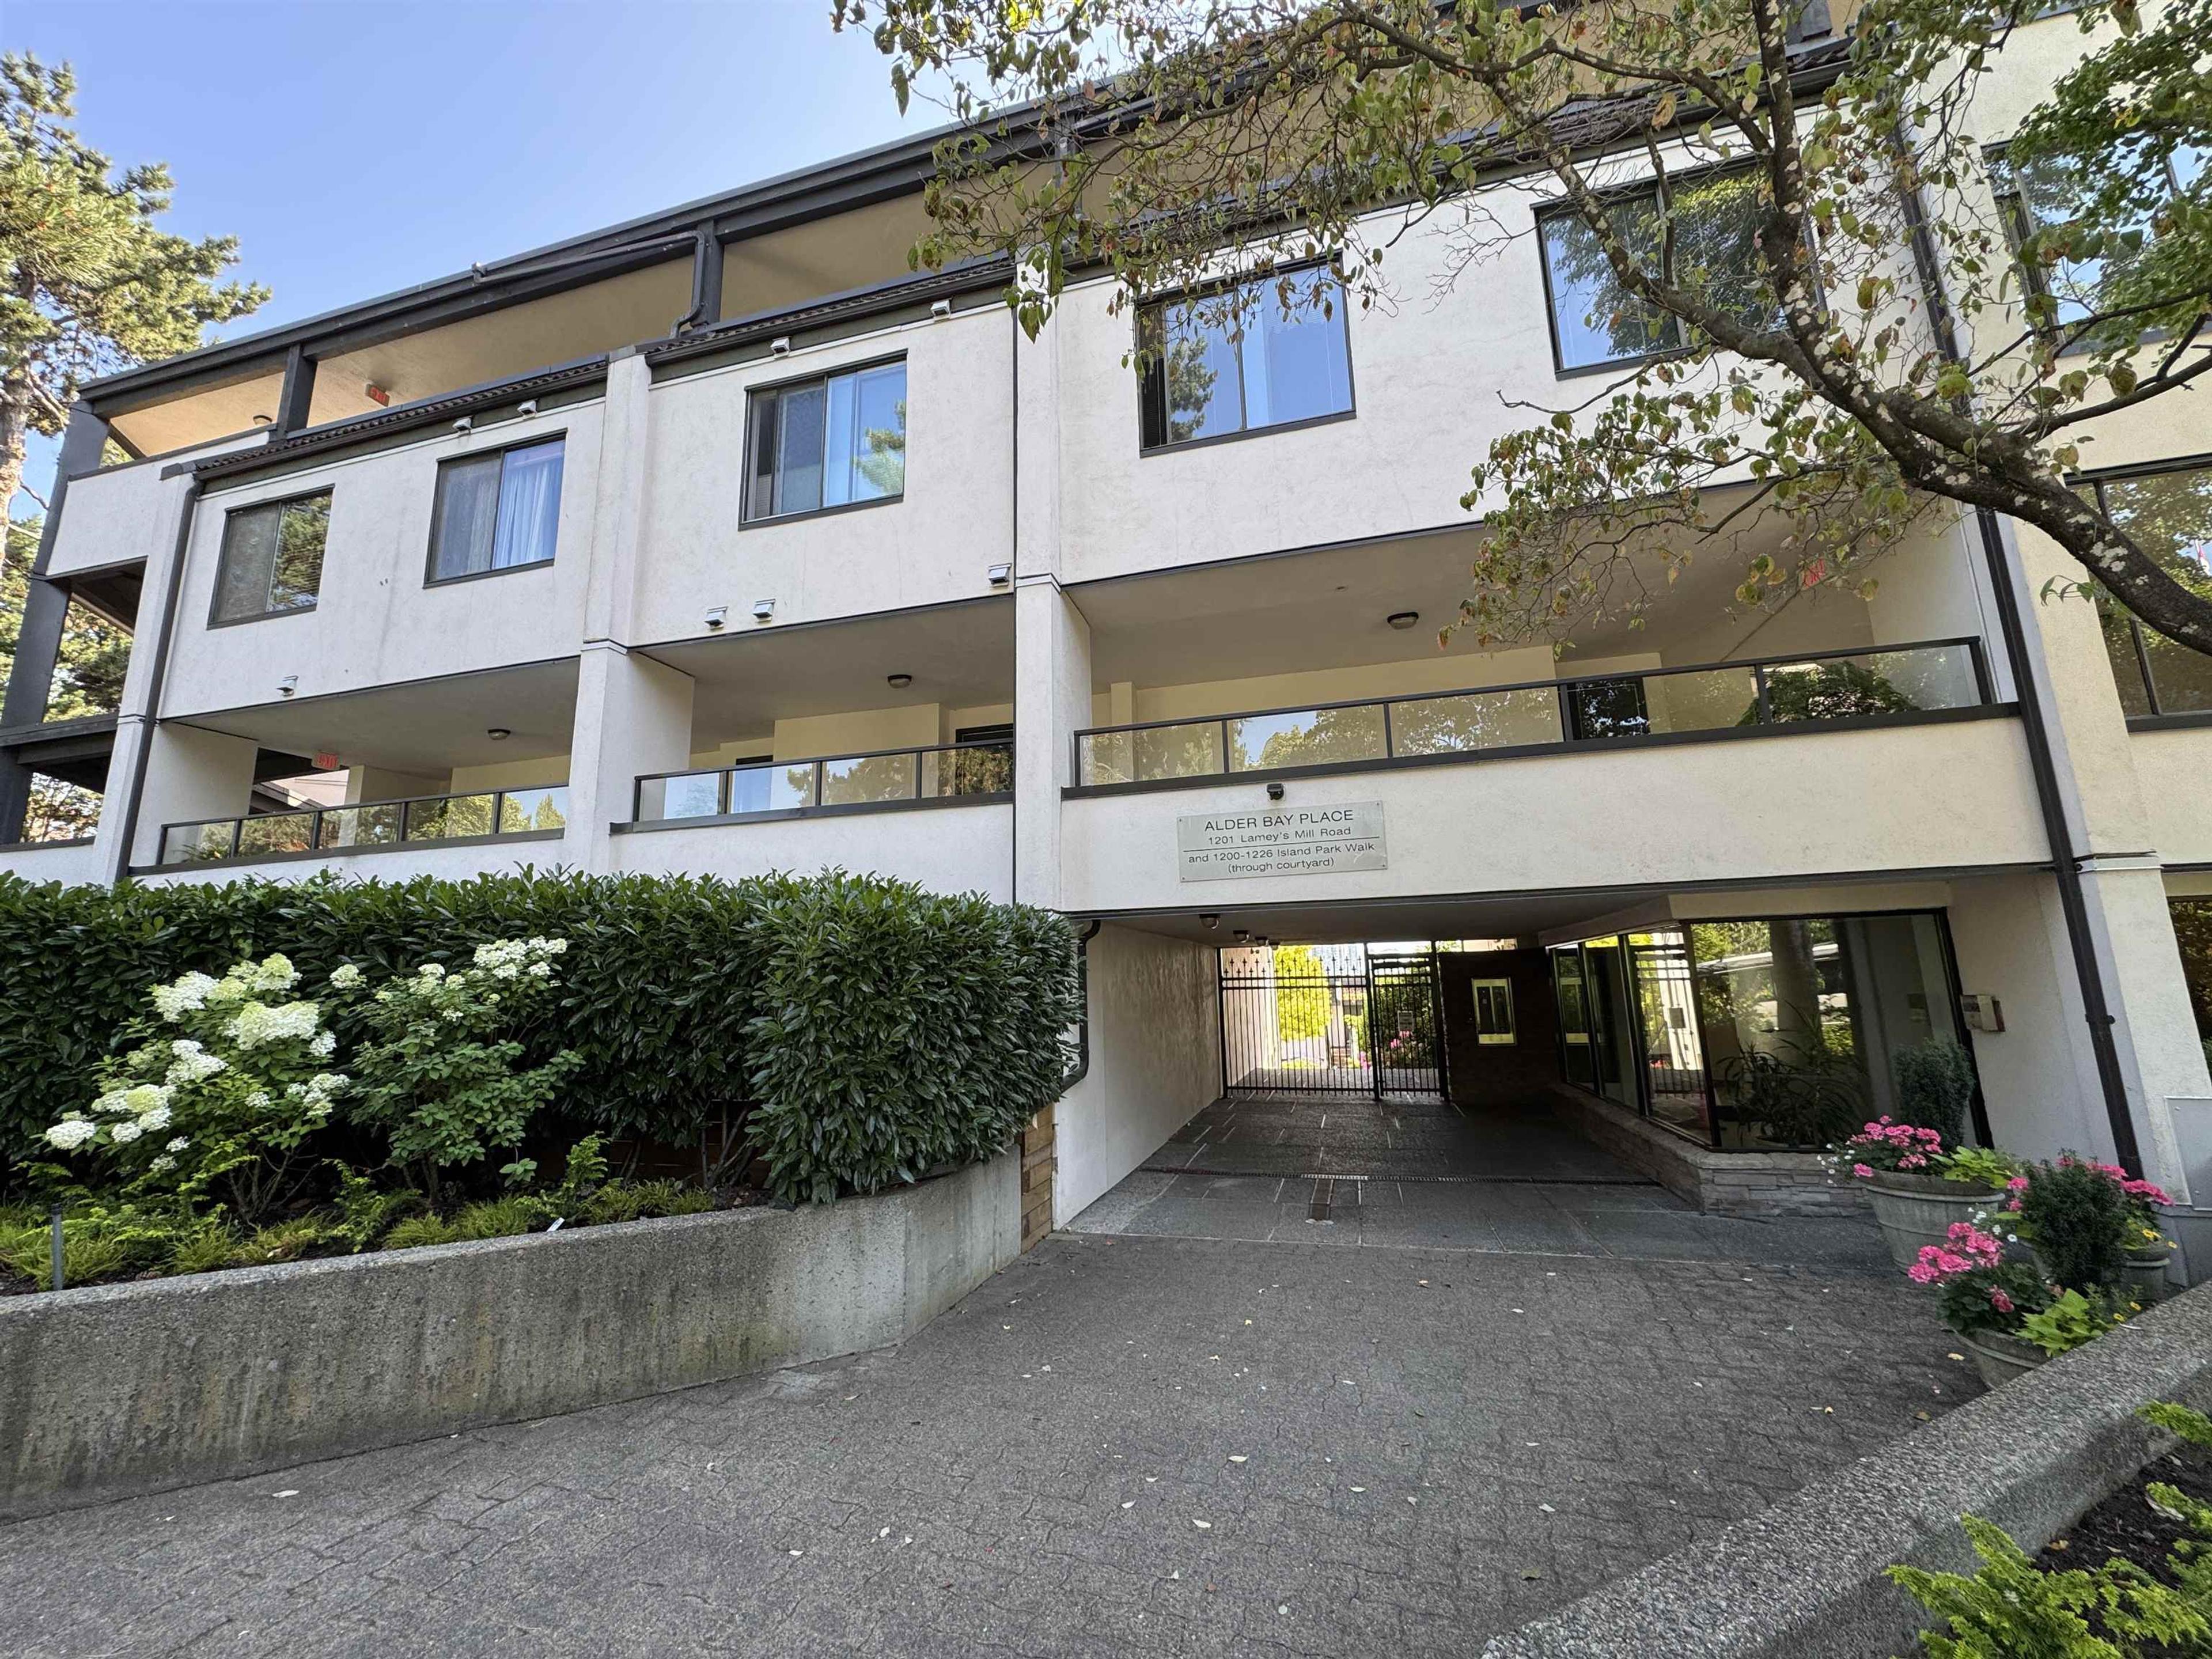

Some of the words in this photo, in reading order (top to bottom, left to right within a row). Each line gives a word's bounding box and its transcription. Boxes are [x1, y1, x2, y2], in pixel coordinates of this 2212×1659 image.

[1205, 817, 1257, 831] ALDER
[1263, 814, 1294, 826] BAY
[1300, 809, 1354, 824] PLACE
[1208, 835, 1233, 845] 1201
[1241, 832, 1290, 843] Lamey's
[1295, 829, 1315, 839] Mill
[1320, 827, 1351, 836] Road
[1188, 854, 1209, 863] and
[1214, 849, 1274, 861] 1200-1226
[1278, 846, 1311, 857] Island
[1315, 844, 1342, 854] Park
[1344, 842, 1376, 853] Walk
[1228, 862, 1272, 874] (through
[1277, 857, 1335, 869] courtyard)
